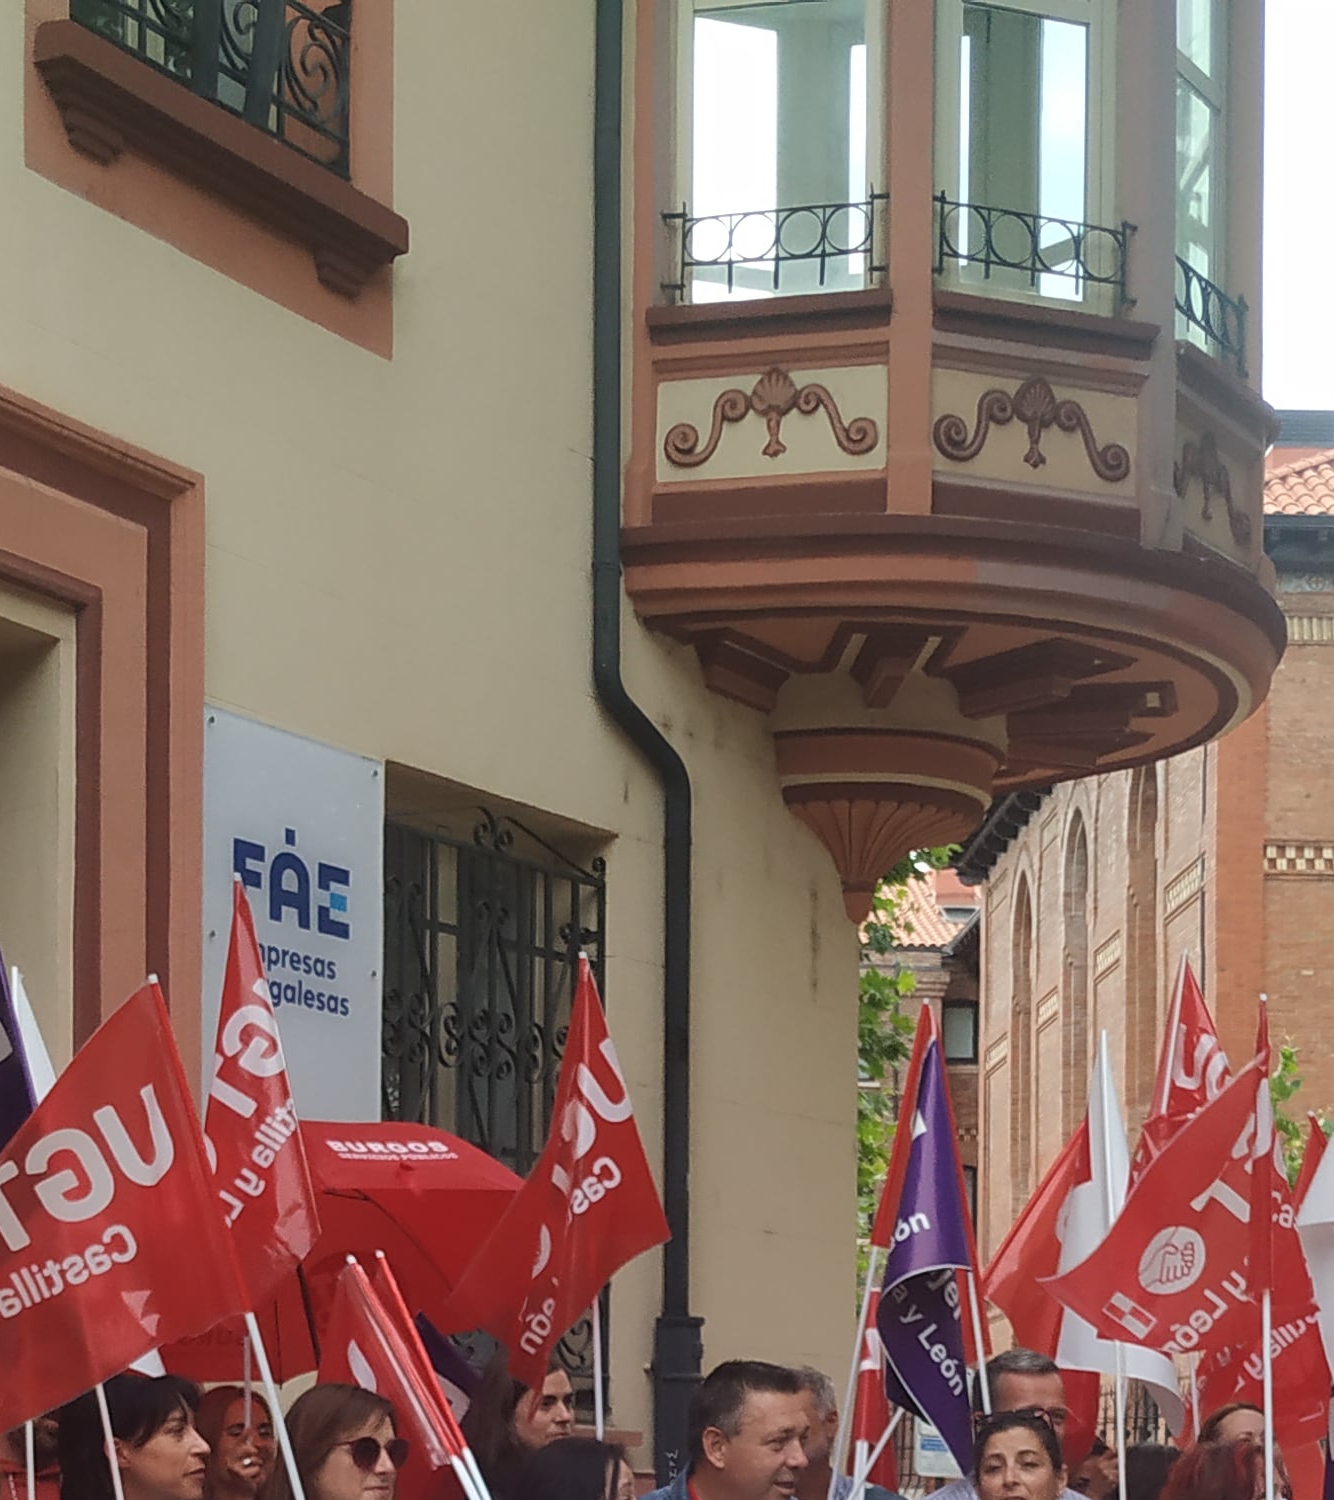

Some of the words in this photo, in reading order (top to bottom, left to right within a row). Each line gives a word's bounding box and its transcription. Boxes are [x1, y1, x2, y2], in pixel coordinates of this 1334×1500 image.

[267, 979, 350, 1018] galesas
[326, 1140, 449, 1154] BURGOS
[899, 1304, 923, 1325] y
[917, 1322, 965, 1397] León
